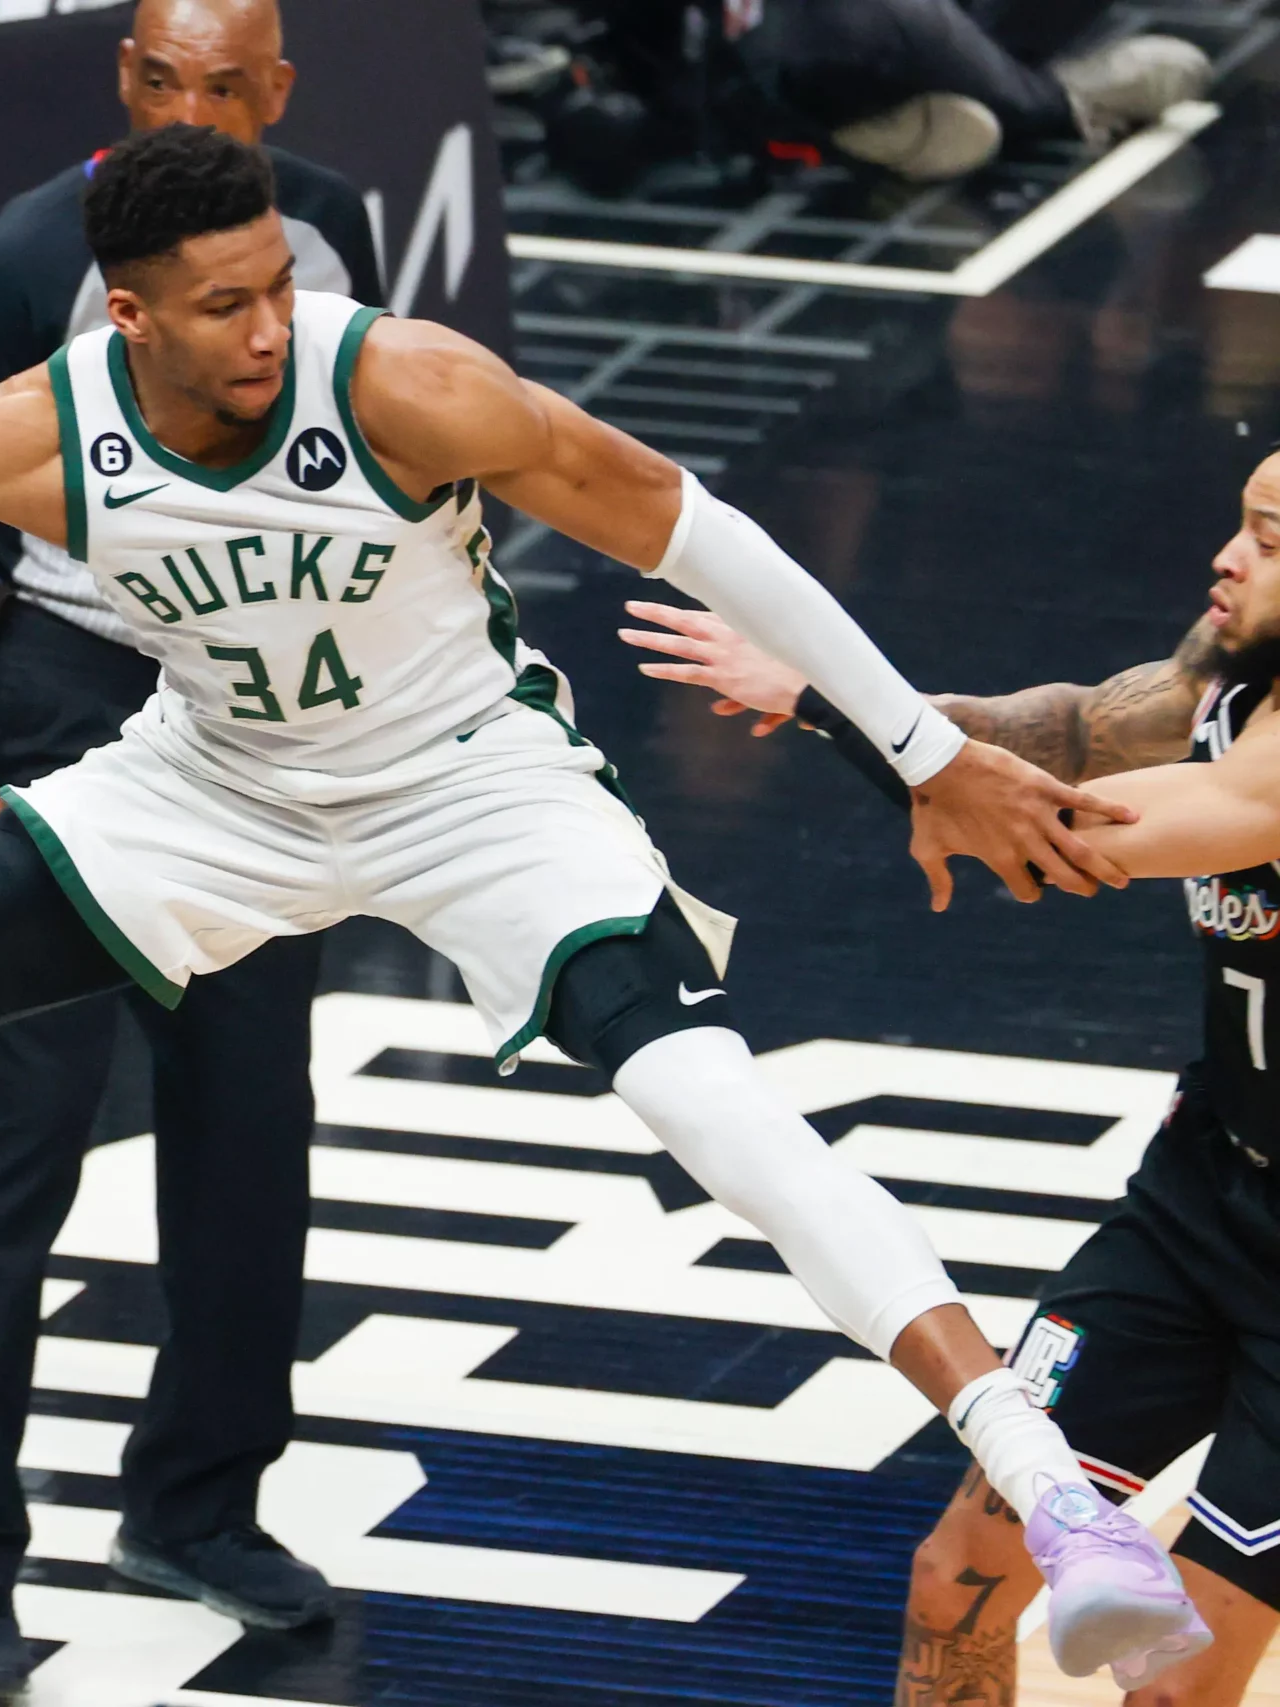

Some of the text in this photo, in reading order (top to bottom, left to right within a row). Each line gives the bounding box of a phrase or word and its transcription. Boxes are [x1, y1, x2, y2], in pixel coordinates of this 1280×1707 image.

[99, 438, 125, 472] 6
[113, 532, 397, 625] BUCKS
[204, 628, 365, 722] 34
[1222, 966, 1268, 1071] 7
[954, 1567, 1007, 1636] 7
